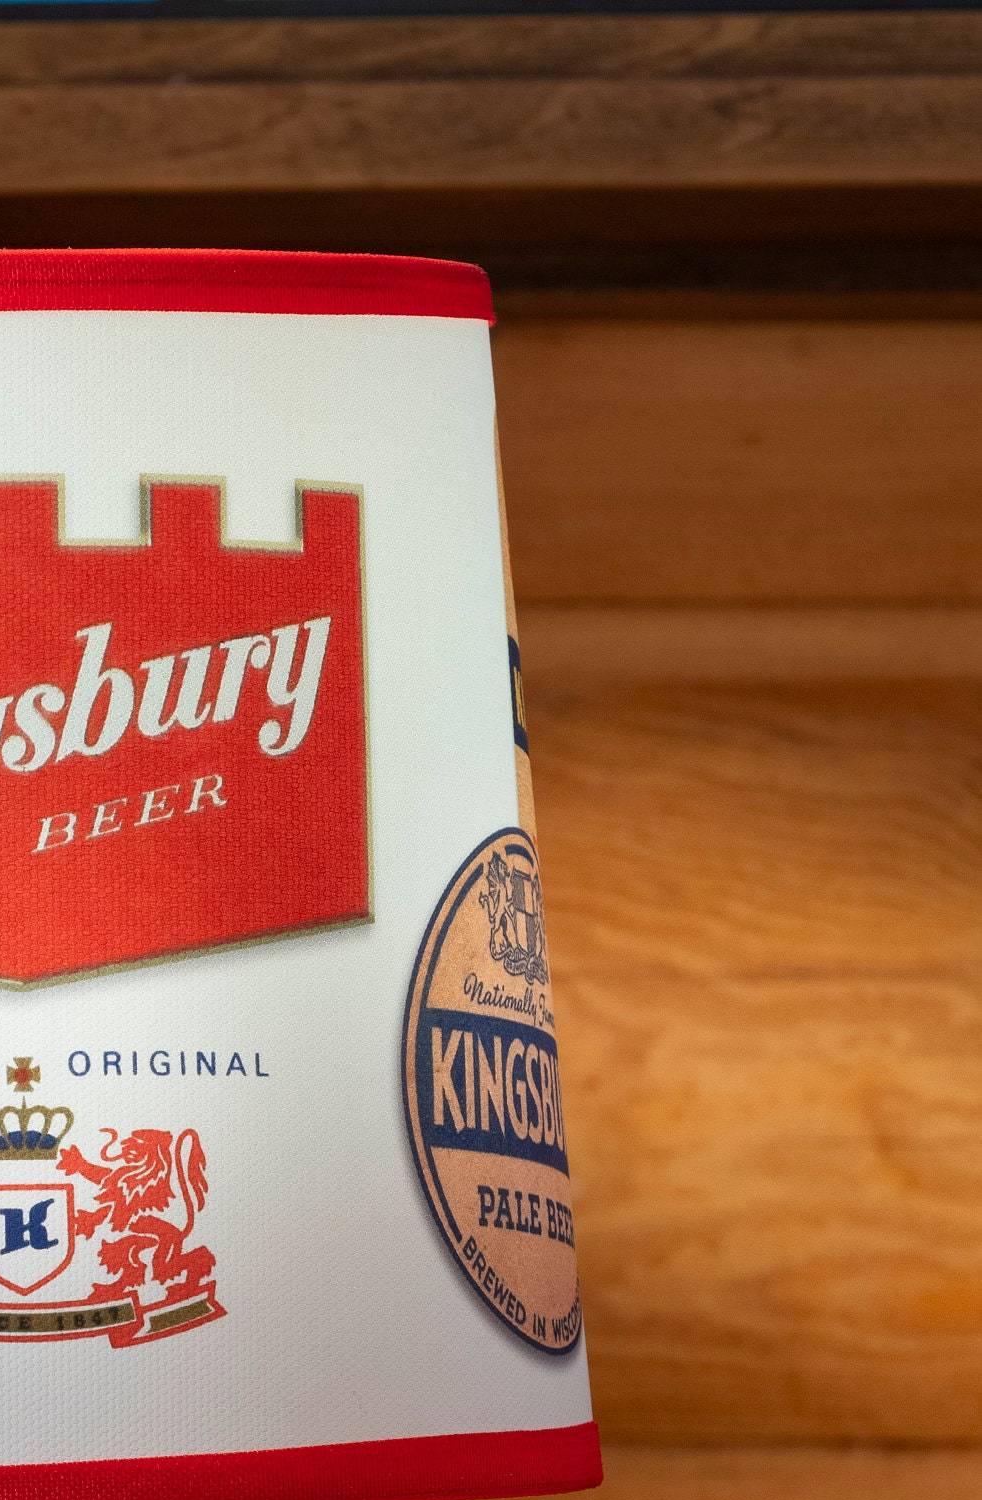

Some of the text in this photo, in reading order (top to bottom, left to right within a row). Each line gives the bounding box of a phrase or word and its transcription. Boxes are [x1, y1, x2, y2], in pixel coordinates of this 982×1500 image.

[31, 772, 229, 855] BEER
[463, 972, 537, 1027] Nationally
[67, 1050, 270, 1078] ORIGINAL
[430, 1026, 566, 1155] KINGSBU
[476, 1184, 543, 1237] PALE
[462, 1234, 527, 1326] BREWED
[532, 1313, 547, 1340] IN
[55, 1305, 122, 1332] 1847
